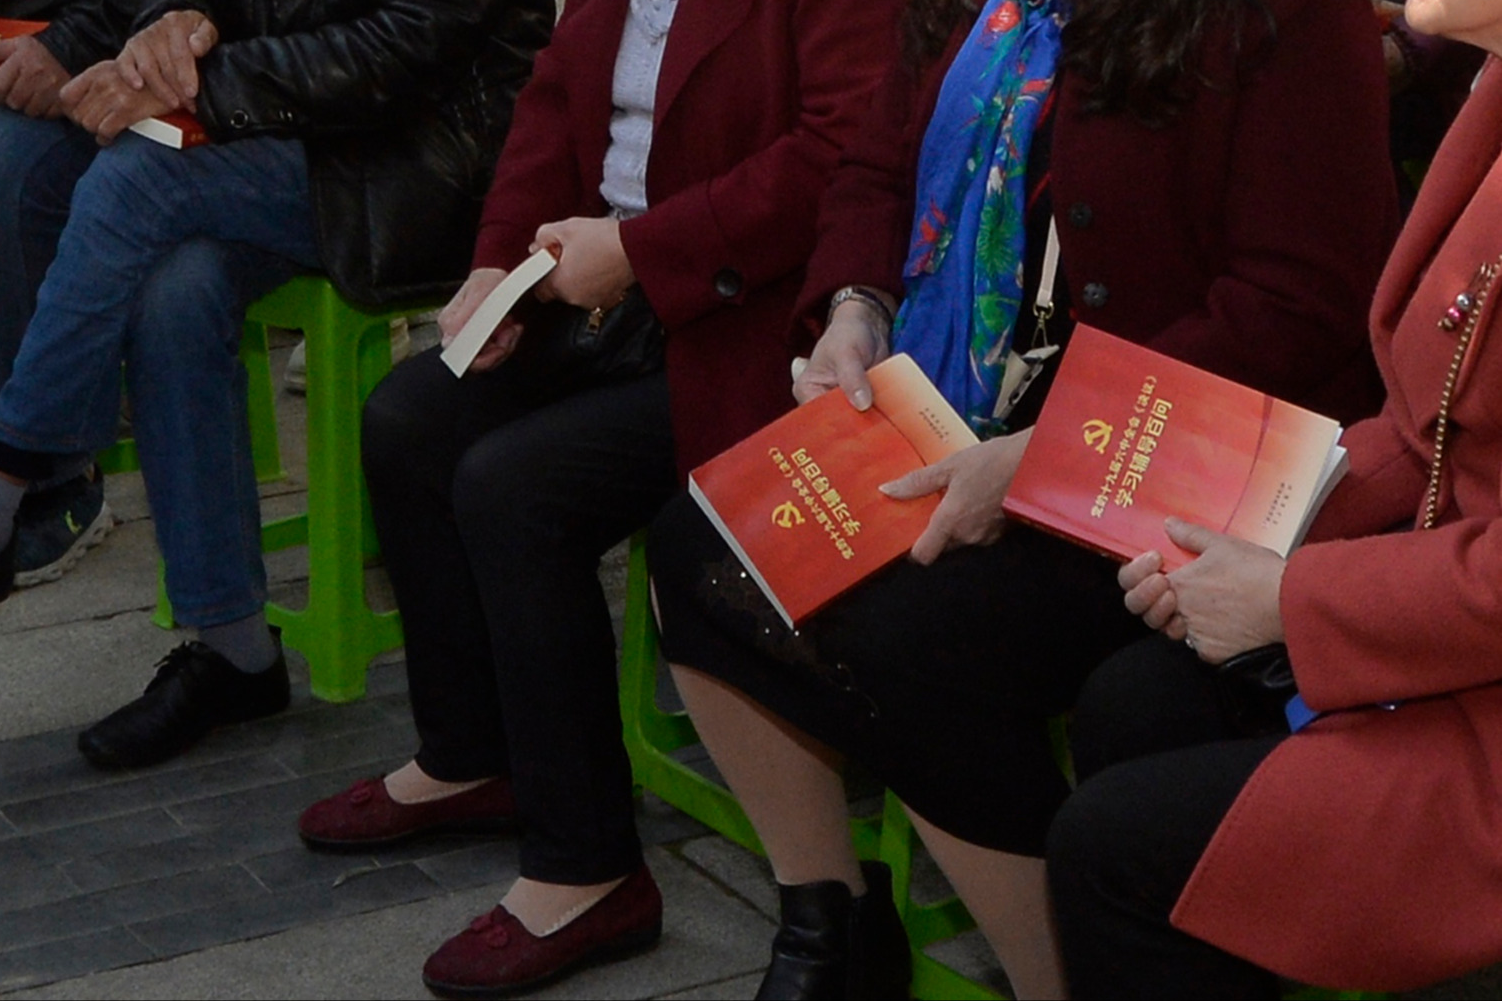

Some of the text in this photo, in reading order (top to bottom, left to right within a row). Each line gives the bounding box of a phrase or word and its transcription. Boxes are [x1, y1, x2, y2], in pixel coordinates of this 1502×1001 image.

[790, 447, 862, 537] 学习辅导百问
[1114, 398, 1174, 509] 学习辅导百问
